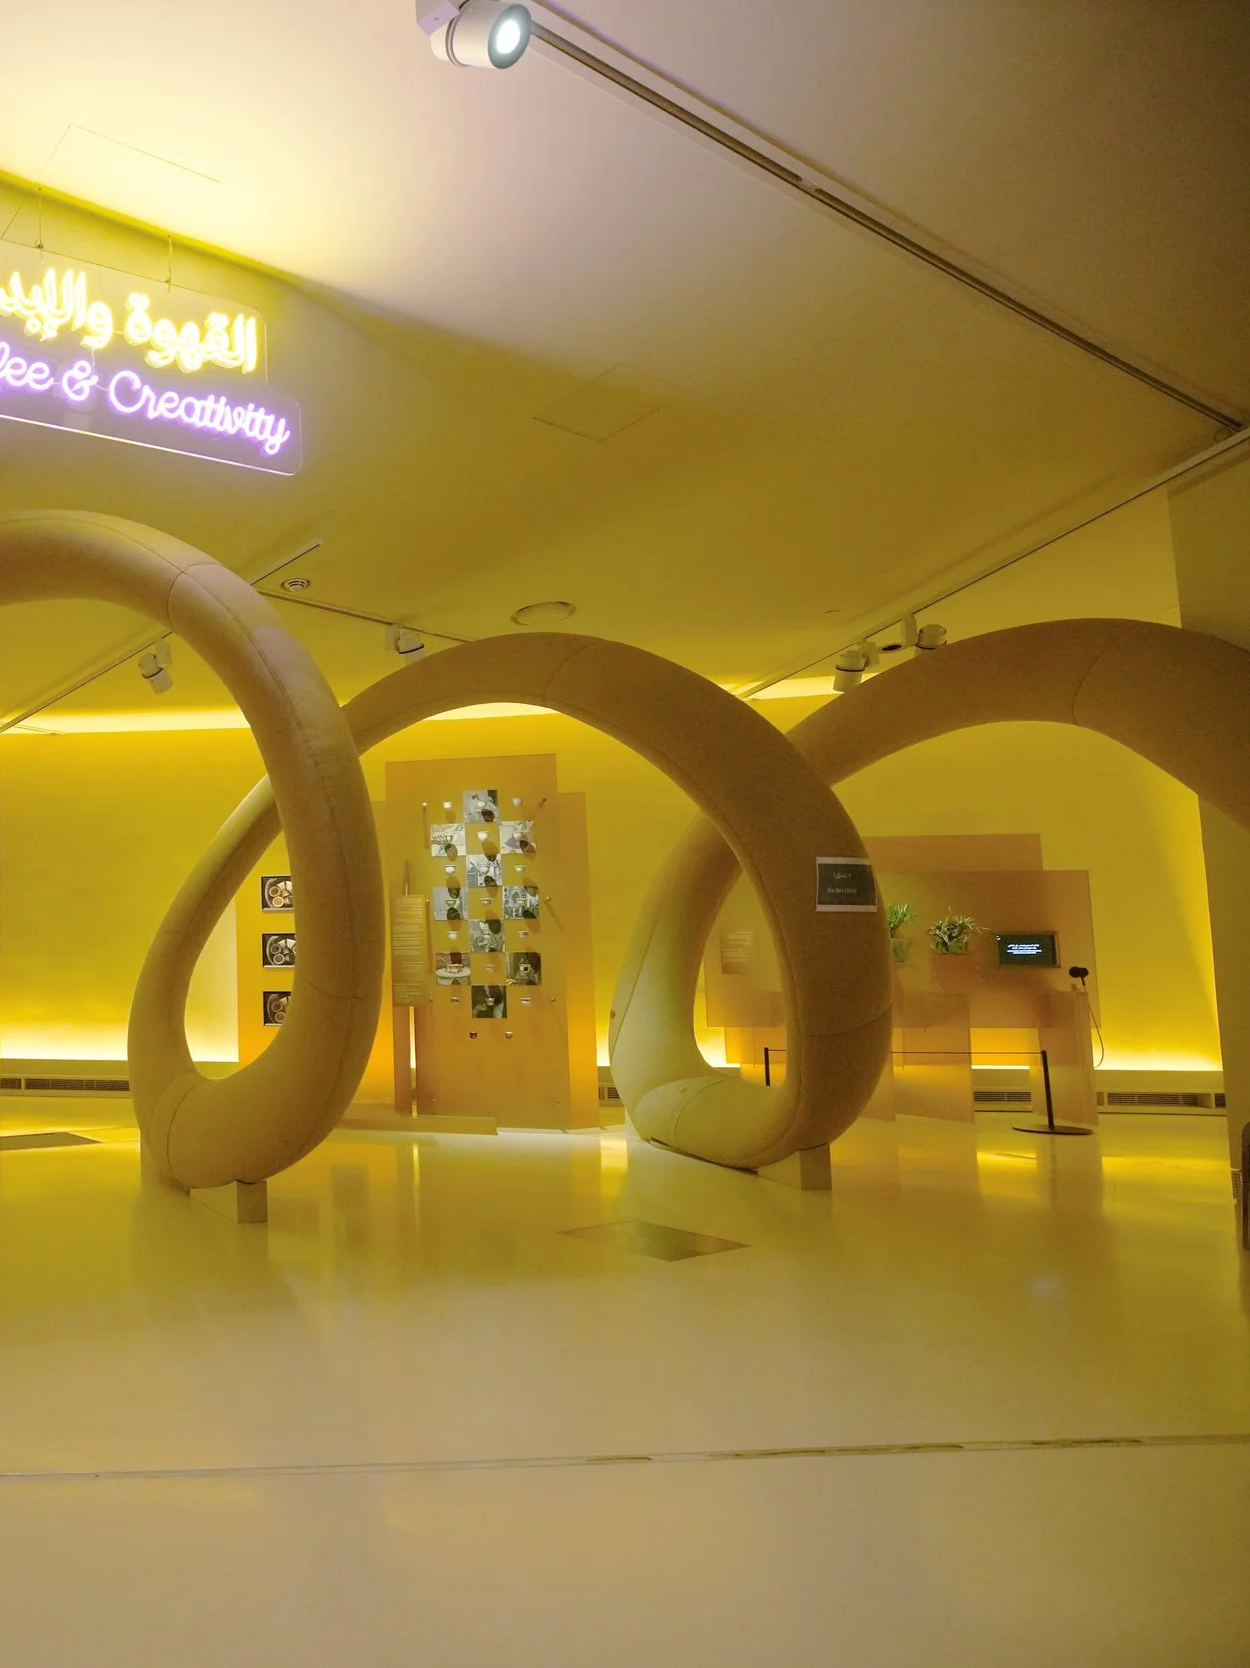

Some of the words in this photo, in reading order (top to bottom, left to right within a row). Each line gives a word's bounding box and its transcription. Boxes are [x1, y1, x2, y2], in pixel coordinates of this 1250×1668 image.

[124, 291, 258, 374] القهوة
[61, 360, 99, 402] &
[107, 369, 291, 456] Creativity
